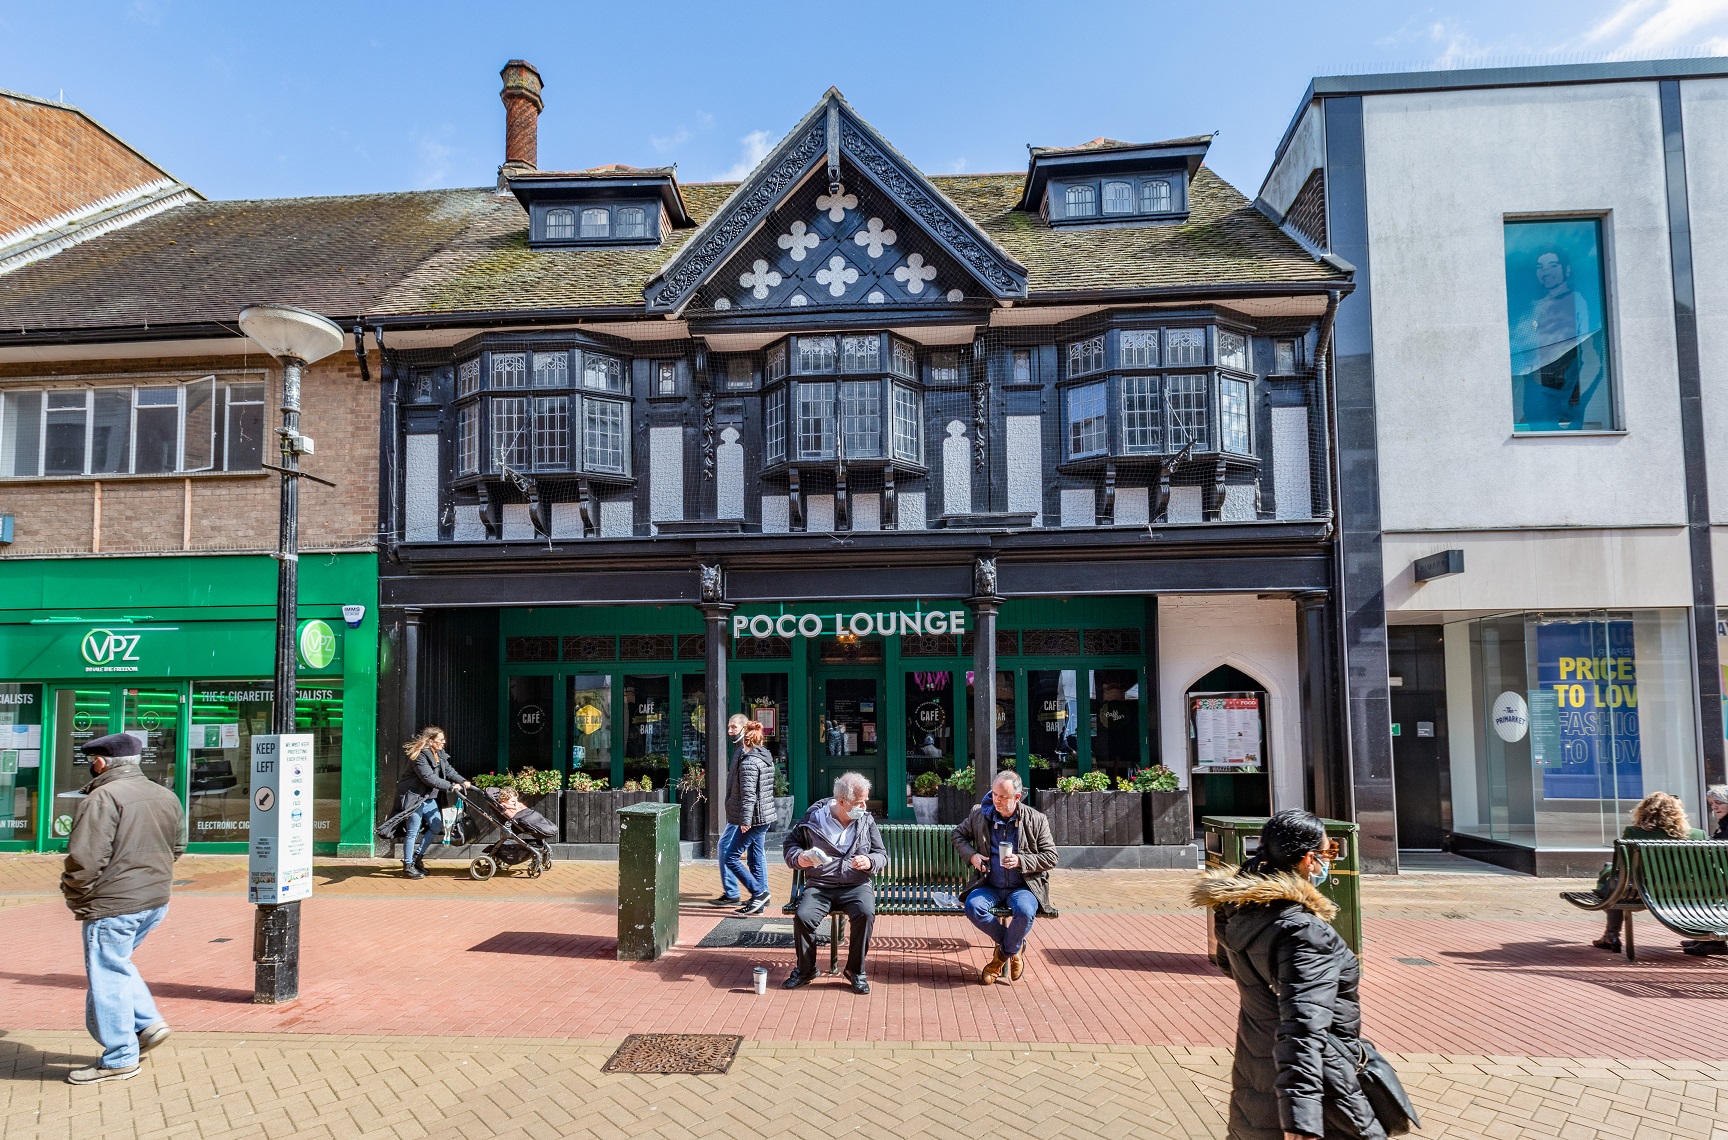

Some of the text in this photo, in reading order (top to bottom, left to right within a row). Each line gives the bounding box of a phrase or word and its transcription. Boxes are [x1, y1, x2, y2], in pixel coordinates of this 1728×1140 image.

[733, 610, 965, 638] POCO LOUNGE
[88, 634, 141, 661] VPZ
[310, 633, 333, 652] VPZ
[1559, 656, 1637, 680] PRICE
[0, 693, 33, 704] IALISTS
[201, 691, 218, 702] THE
[296, 690, 333, 701] IALISTS
[1553, 684, 1638, 708] TO LOV
[638, 703, 655, 714] CAFÉ
[522, 711, 541, 724] CAFÉ
[920, 708, 940, 721] CAFÉ
[995, 712, 1006, 721] AR
[1495, 715, 1526, 726] PRIMARKET
[1558, 711, 1640, 736] FASHIO
[640, 724, 653, 735] BAR
[1045, 721, 1060, 732] BAR
[256, 743, 276, 754] KEEP
[1559, 738, 1641, 764] TO LOV
[256, 761, 275, 773] LEFT
[7, 819, 28, 829] TRUST
[197, 820, 250, 830] ELECTRONIC CIG
[313, 820, 331, 829] RUST
